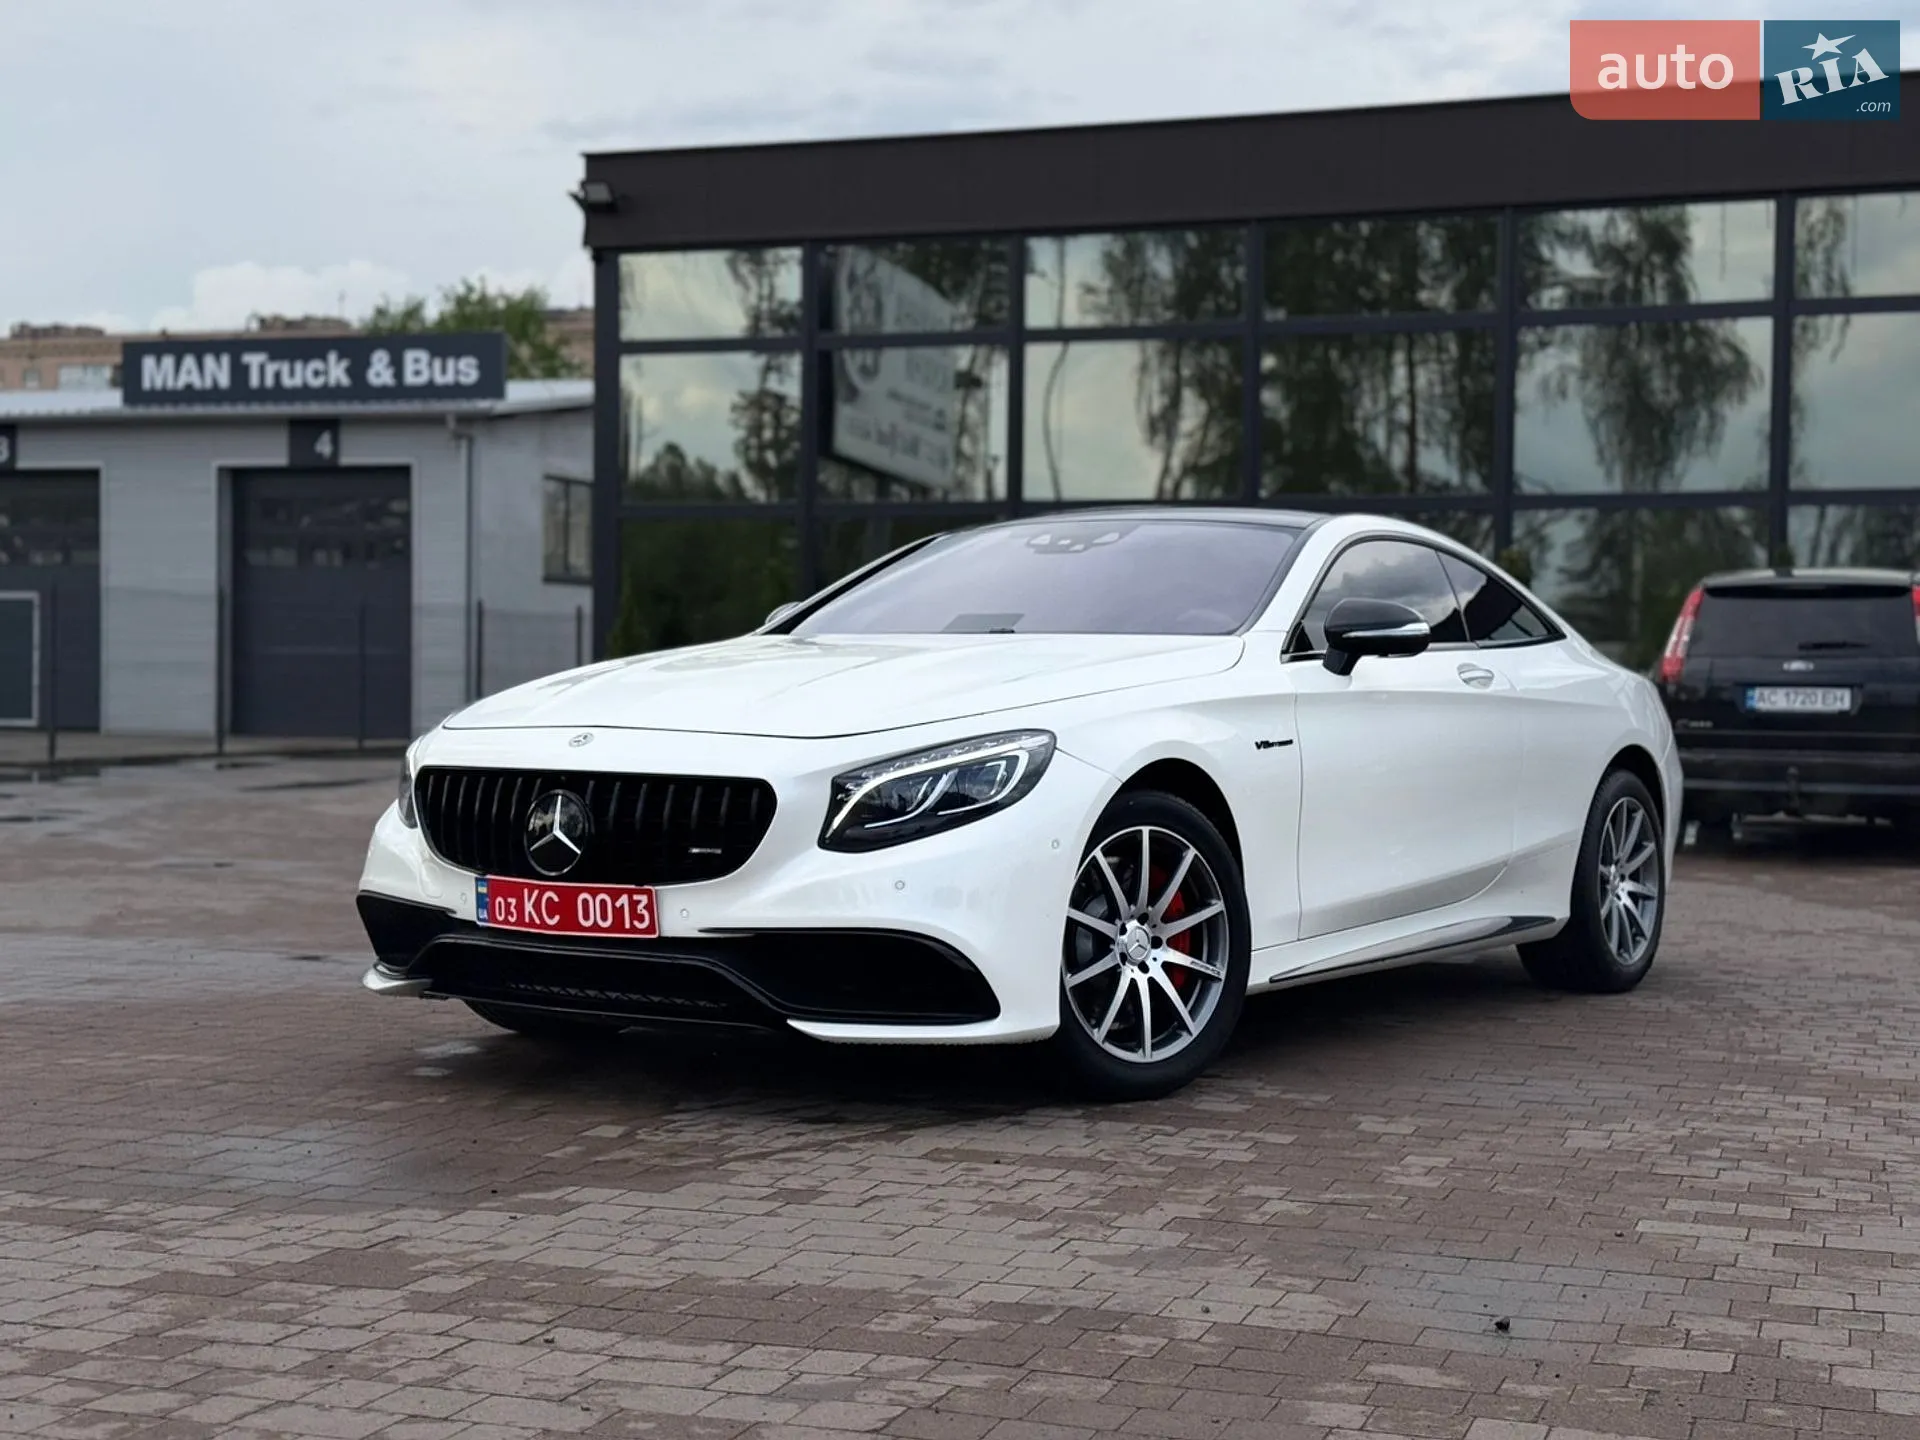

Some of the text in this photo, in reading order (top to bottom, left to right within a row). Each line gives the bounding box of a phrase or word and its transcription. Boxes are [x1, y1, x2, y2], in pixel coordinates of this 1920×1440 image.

[141, 348, 480, 391] MAN Truck & Bus
[314, 429, 334, 460] 4
[495, 887, 651, 930] 03 KC 0013
